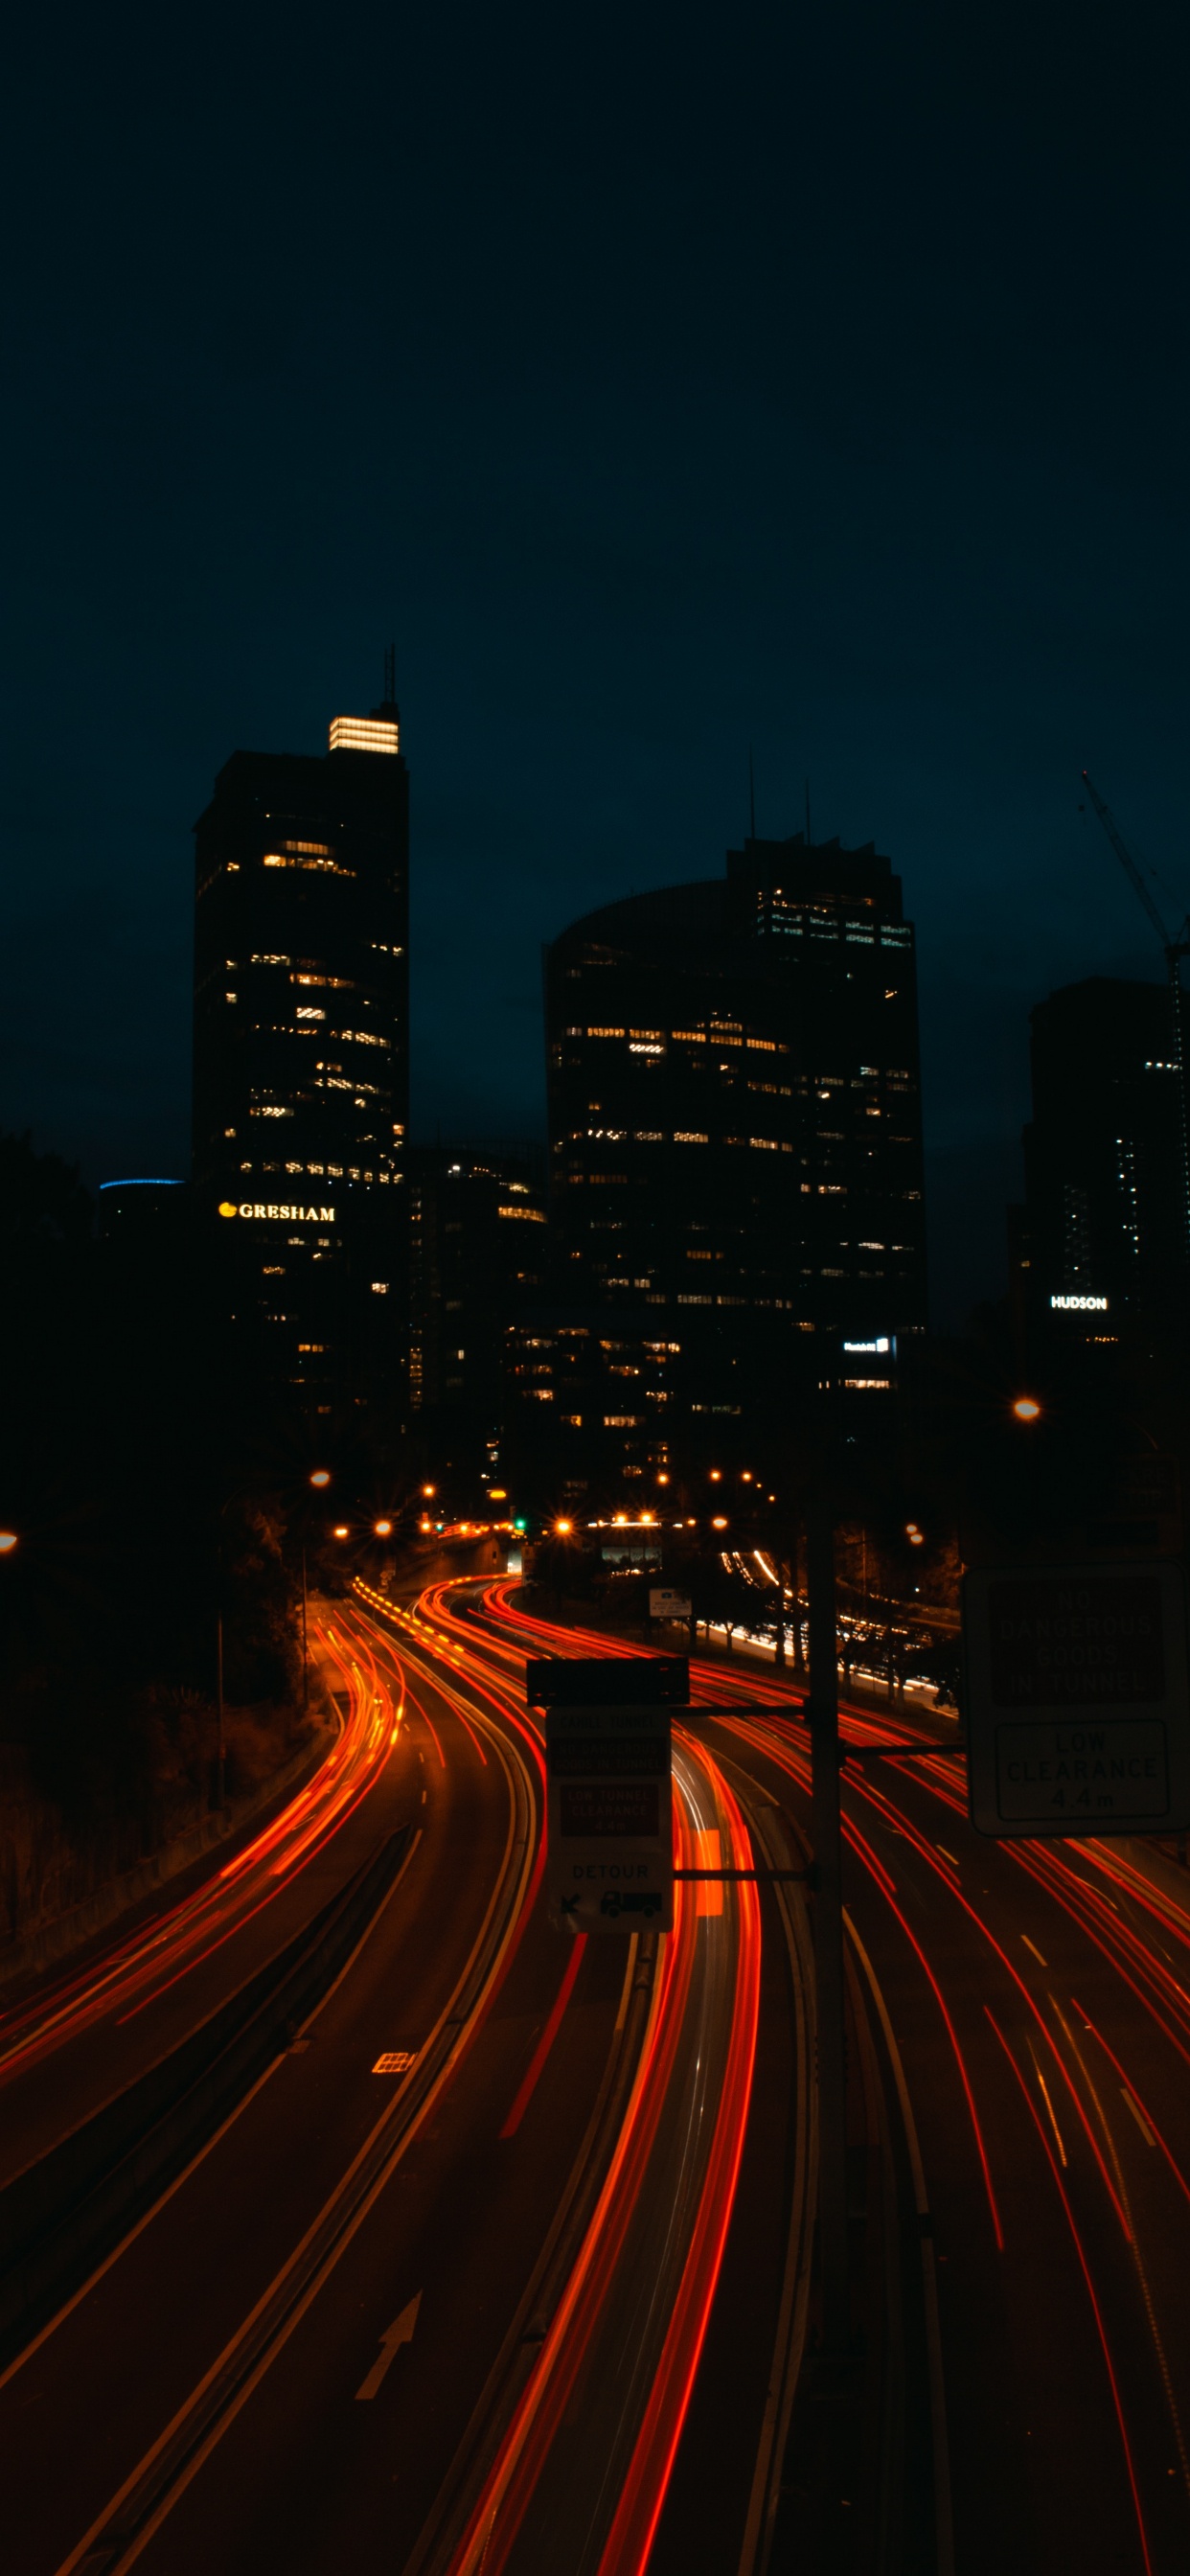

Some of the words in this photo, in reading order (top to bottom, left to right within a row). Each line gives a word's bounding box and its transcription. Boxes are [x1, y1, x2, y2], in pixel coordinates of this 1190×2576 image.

[240, 1204, 335, 1221] GRESHAM
[1051, 1296, 1108, 1310] HUDSON
[1058, 1590, 1090, 1611] NO
[1000, 1615, 1152, 1640] DANGEROUS
[1037, 1644, 1118, 1667] GOODS
[1011, 1673, 1033, 1695] IN
[1050, 1670, 1146, 1693] TUNNEL
[1056, 1732, 1106, 1753] LOW
[1007, 1758, 1157, 1782] CLEARANCE
[571, 1805, 648, 1817] CLEARANCE
[572, 1864, 649, 1879] DETOUR
